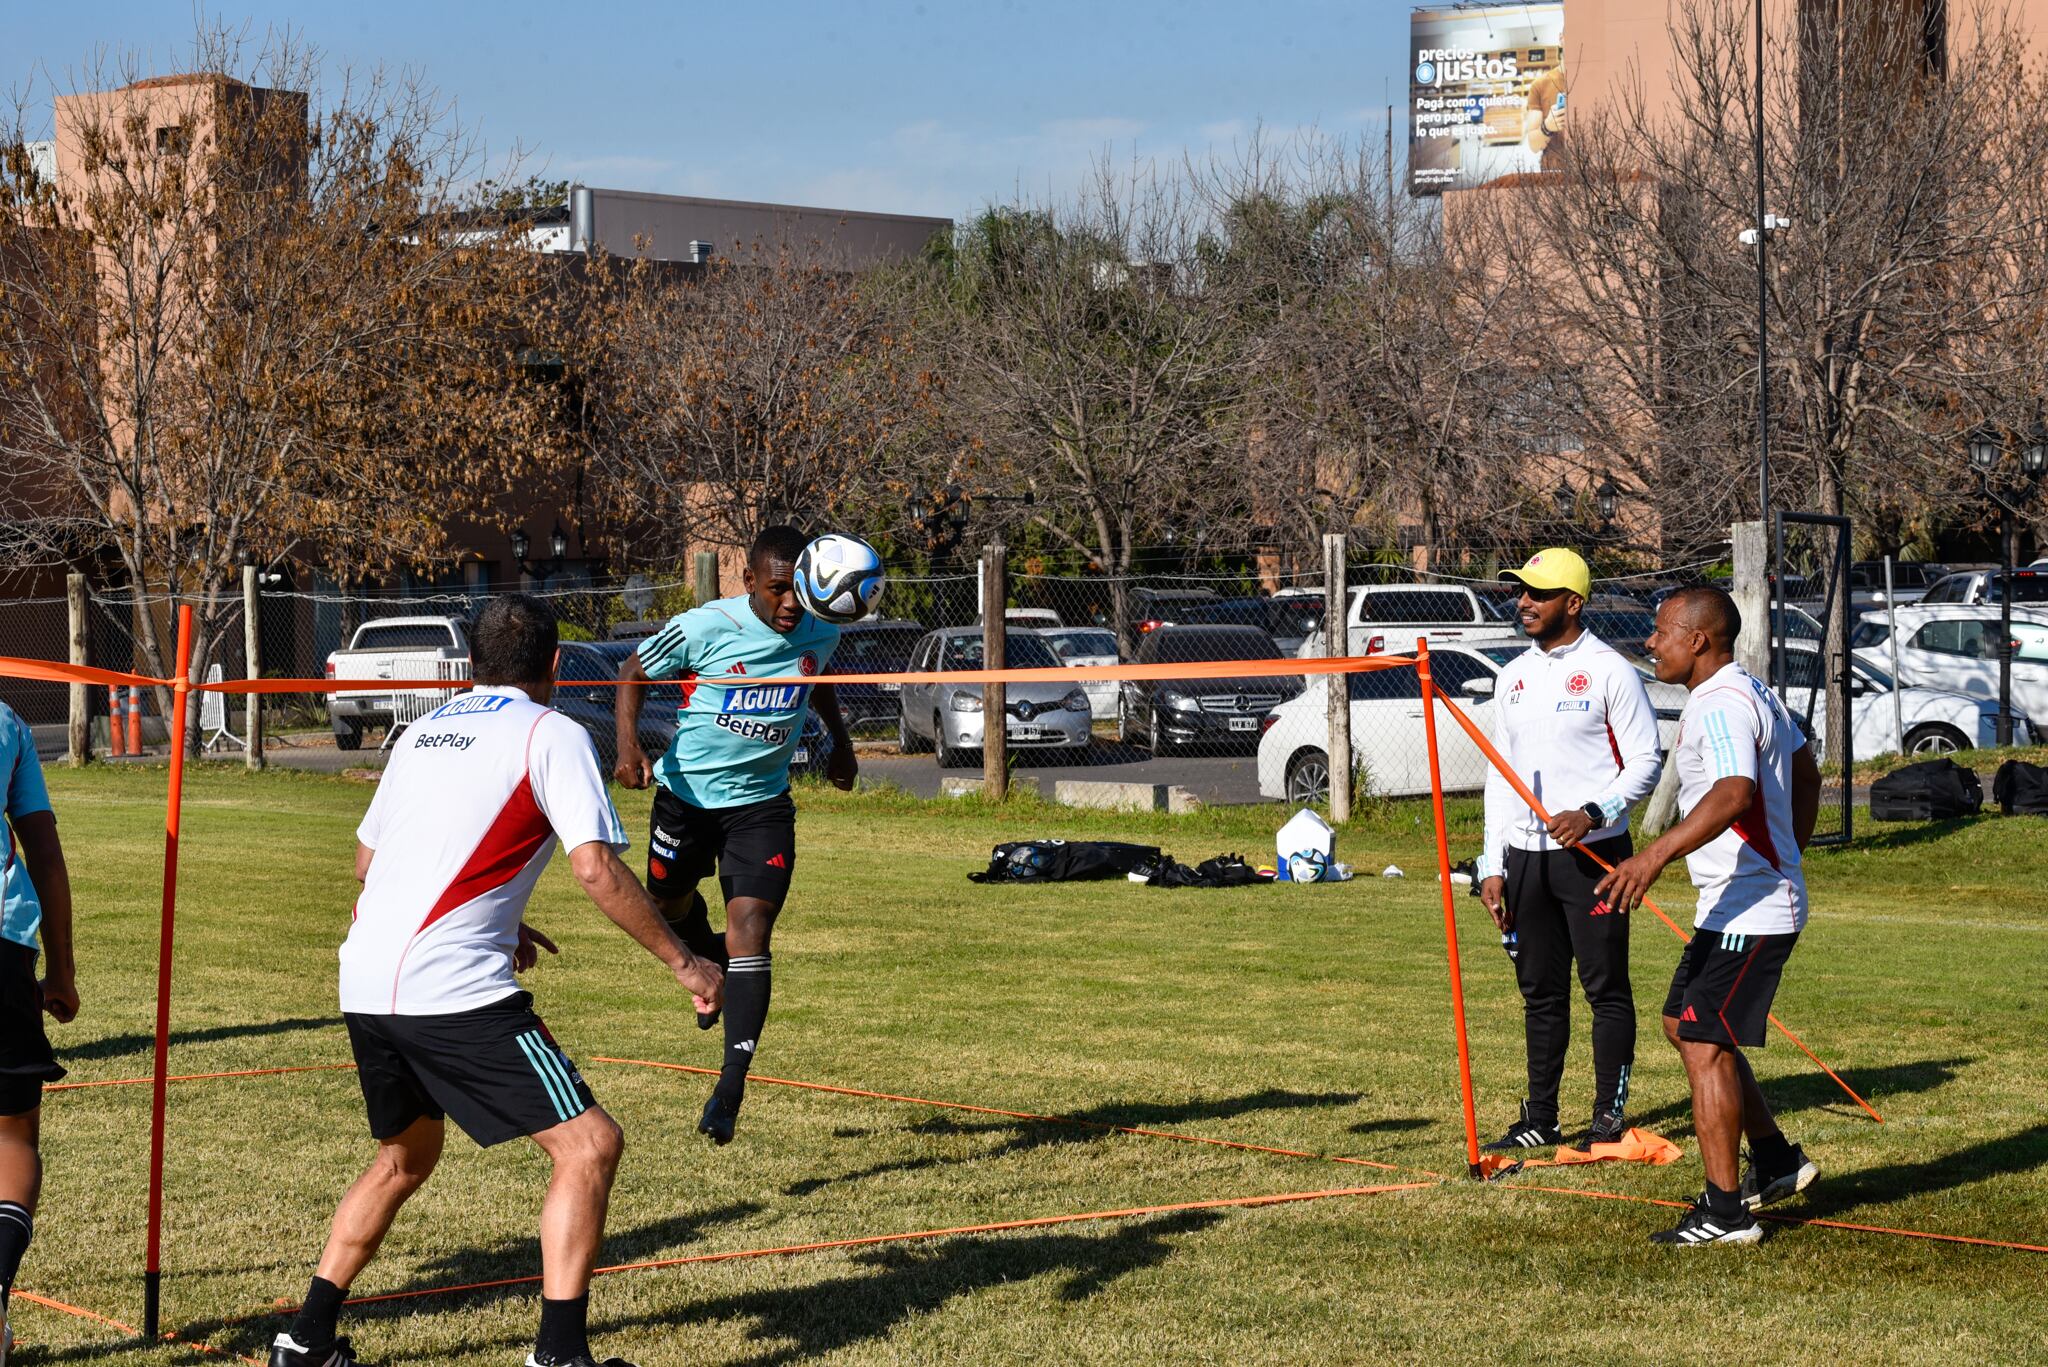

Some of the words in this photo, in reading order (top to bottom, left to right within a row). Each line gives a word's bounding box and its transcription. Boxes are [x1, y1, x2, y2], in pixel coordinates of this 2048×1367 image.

[1419, 44, 1475, 64] precios
[1434, 54, 1517, 88] justos
[1416, 97, 1444, 111] Pagá
[1446, 98, 1476, 108] como
[1416, 113, 1441, 126] pero
[1444, 109, 1472, 125] pagá
[1416, 125, 1427, 137] lo
[1429, 127, 1450, 139] que
[1451, 126, 1466, 136] es
[715, 714, 791, 745] BetPlay
[414, 732, 477, 751] BetPlay
